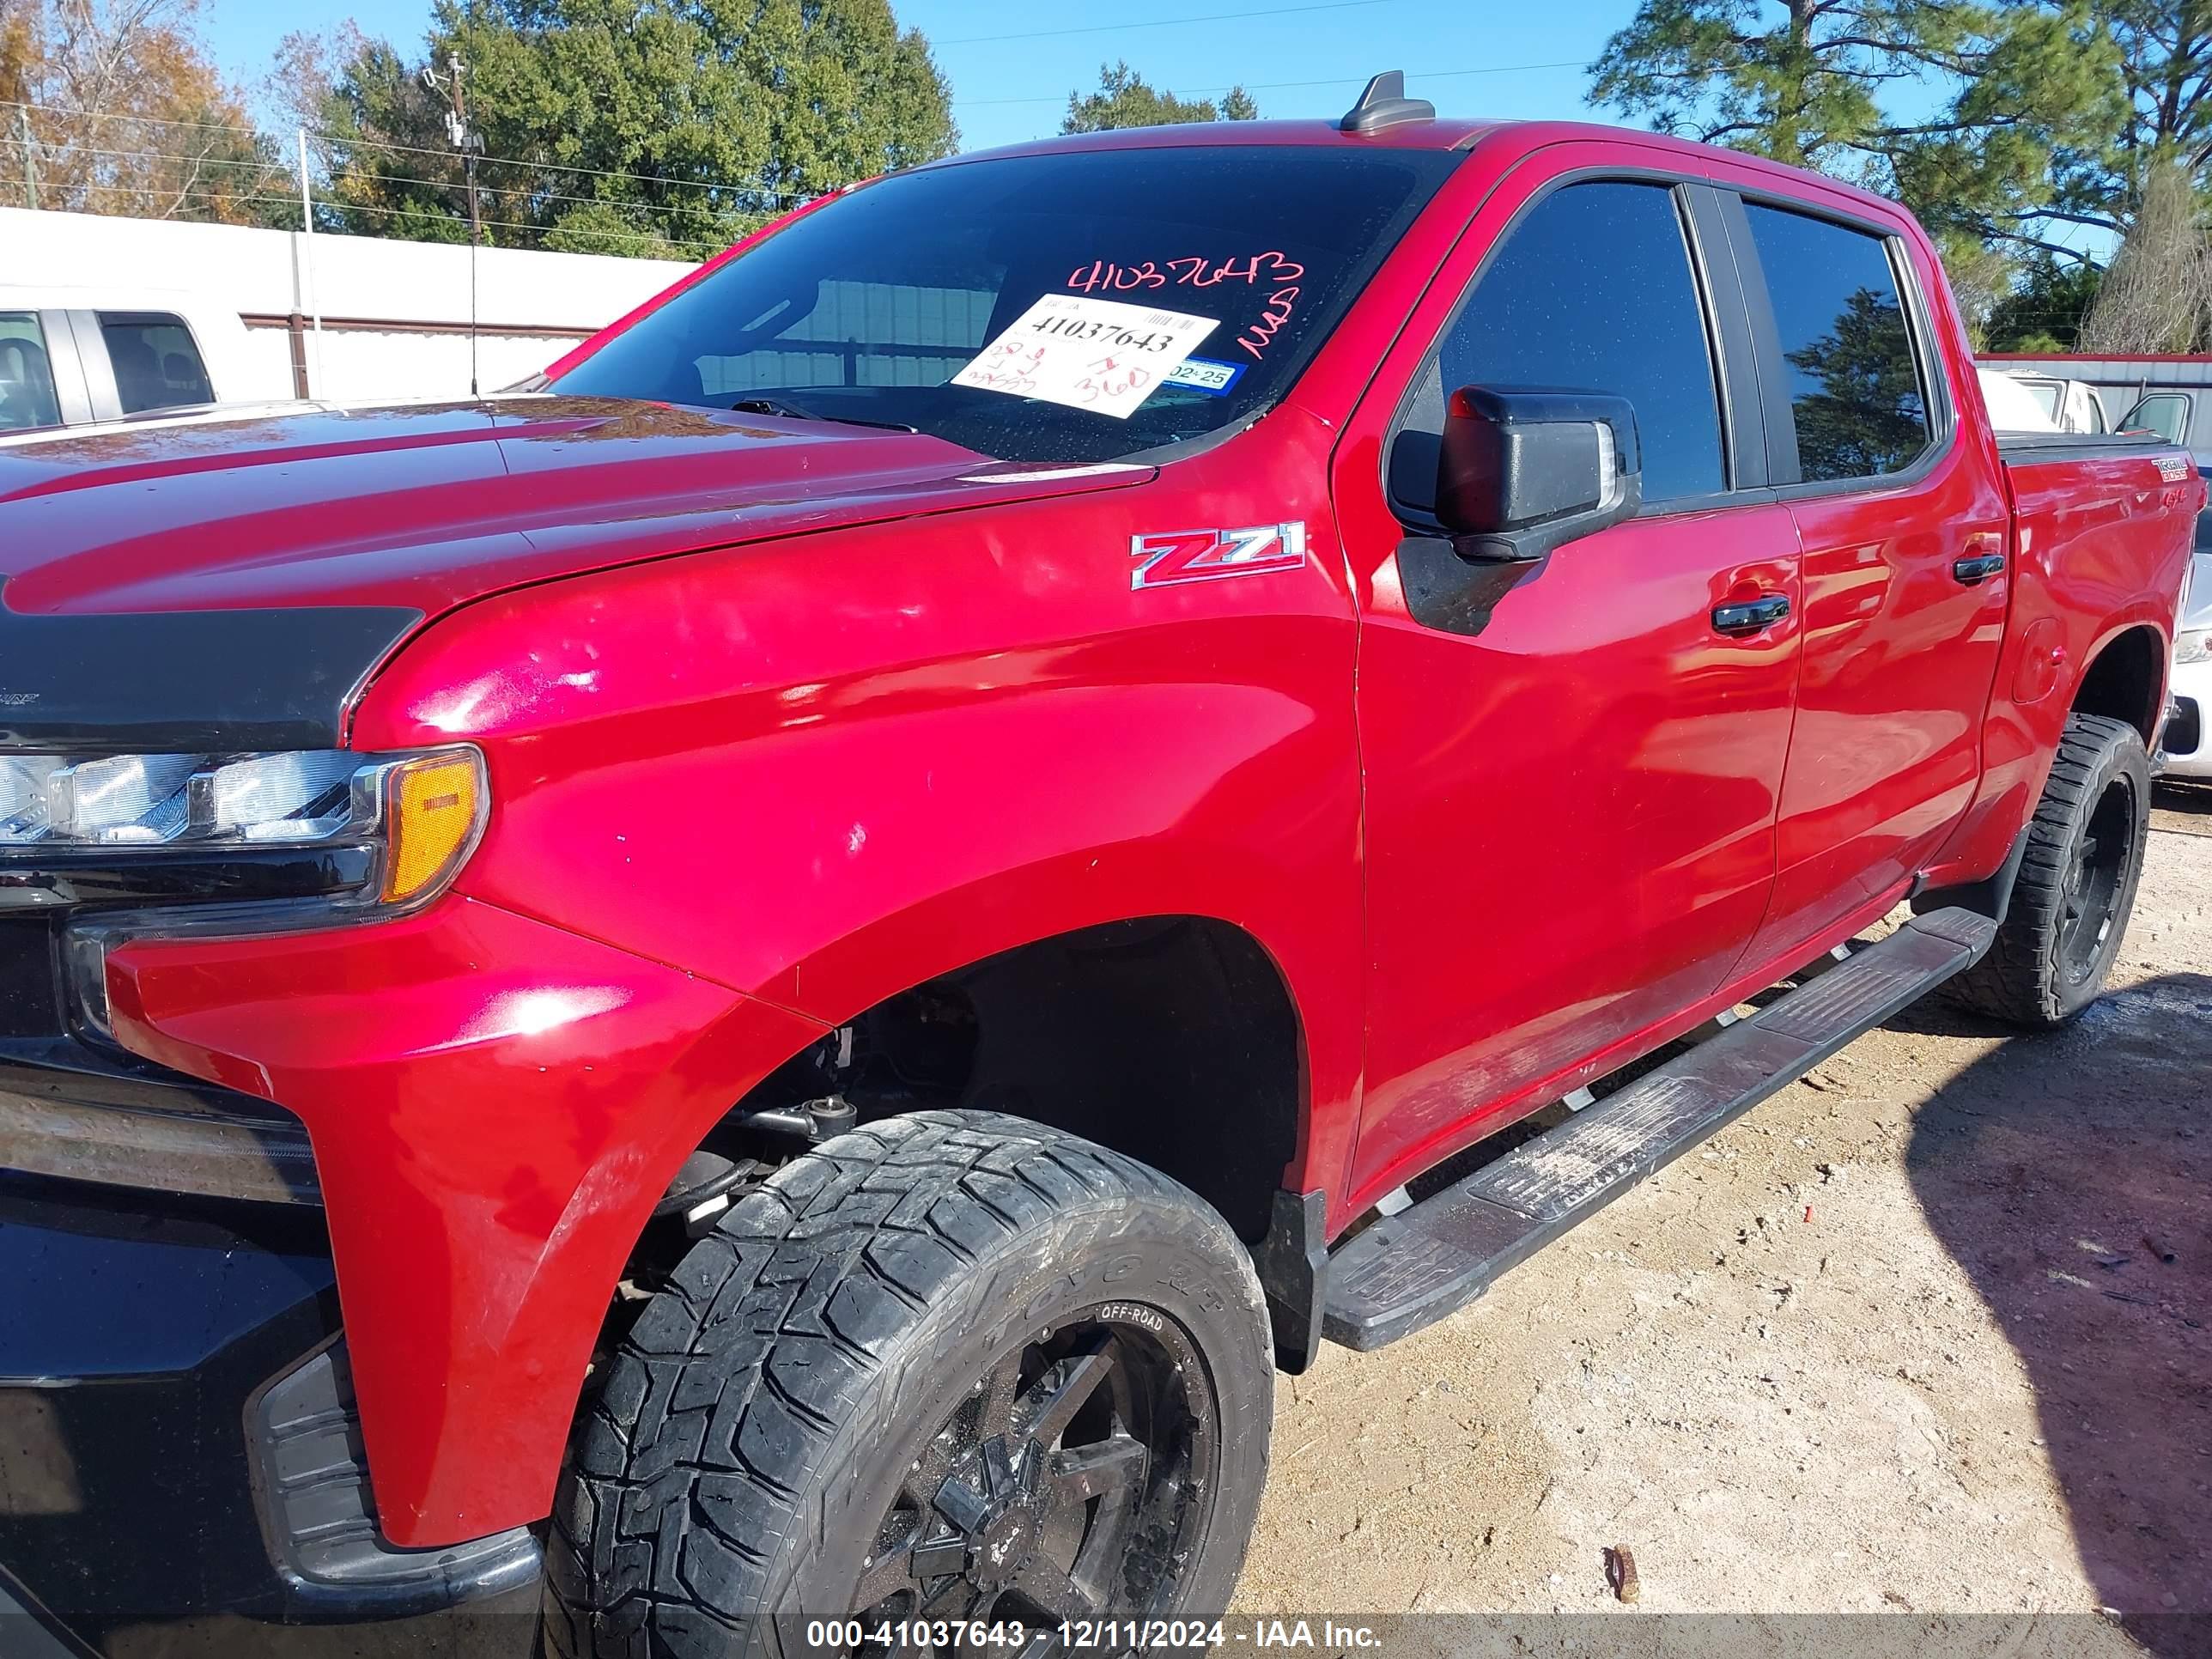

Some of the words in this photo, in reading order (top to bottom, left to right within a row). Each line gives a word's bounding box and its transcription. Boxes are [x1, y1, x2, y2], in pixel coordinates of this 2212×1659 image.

[1067, 252, 1304, 293] 41037643
[1032, 316, 1174, 353] 41037643
[1200, 371, 1227, 384] 25
[2151, 458, 2188, 471] TRAIL
[2162, 470, 2187, 482] BOSS
[1129, 520, 1306, 591] Z71
[1101, 1305, 1163, 1331] OFF-ROAD
